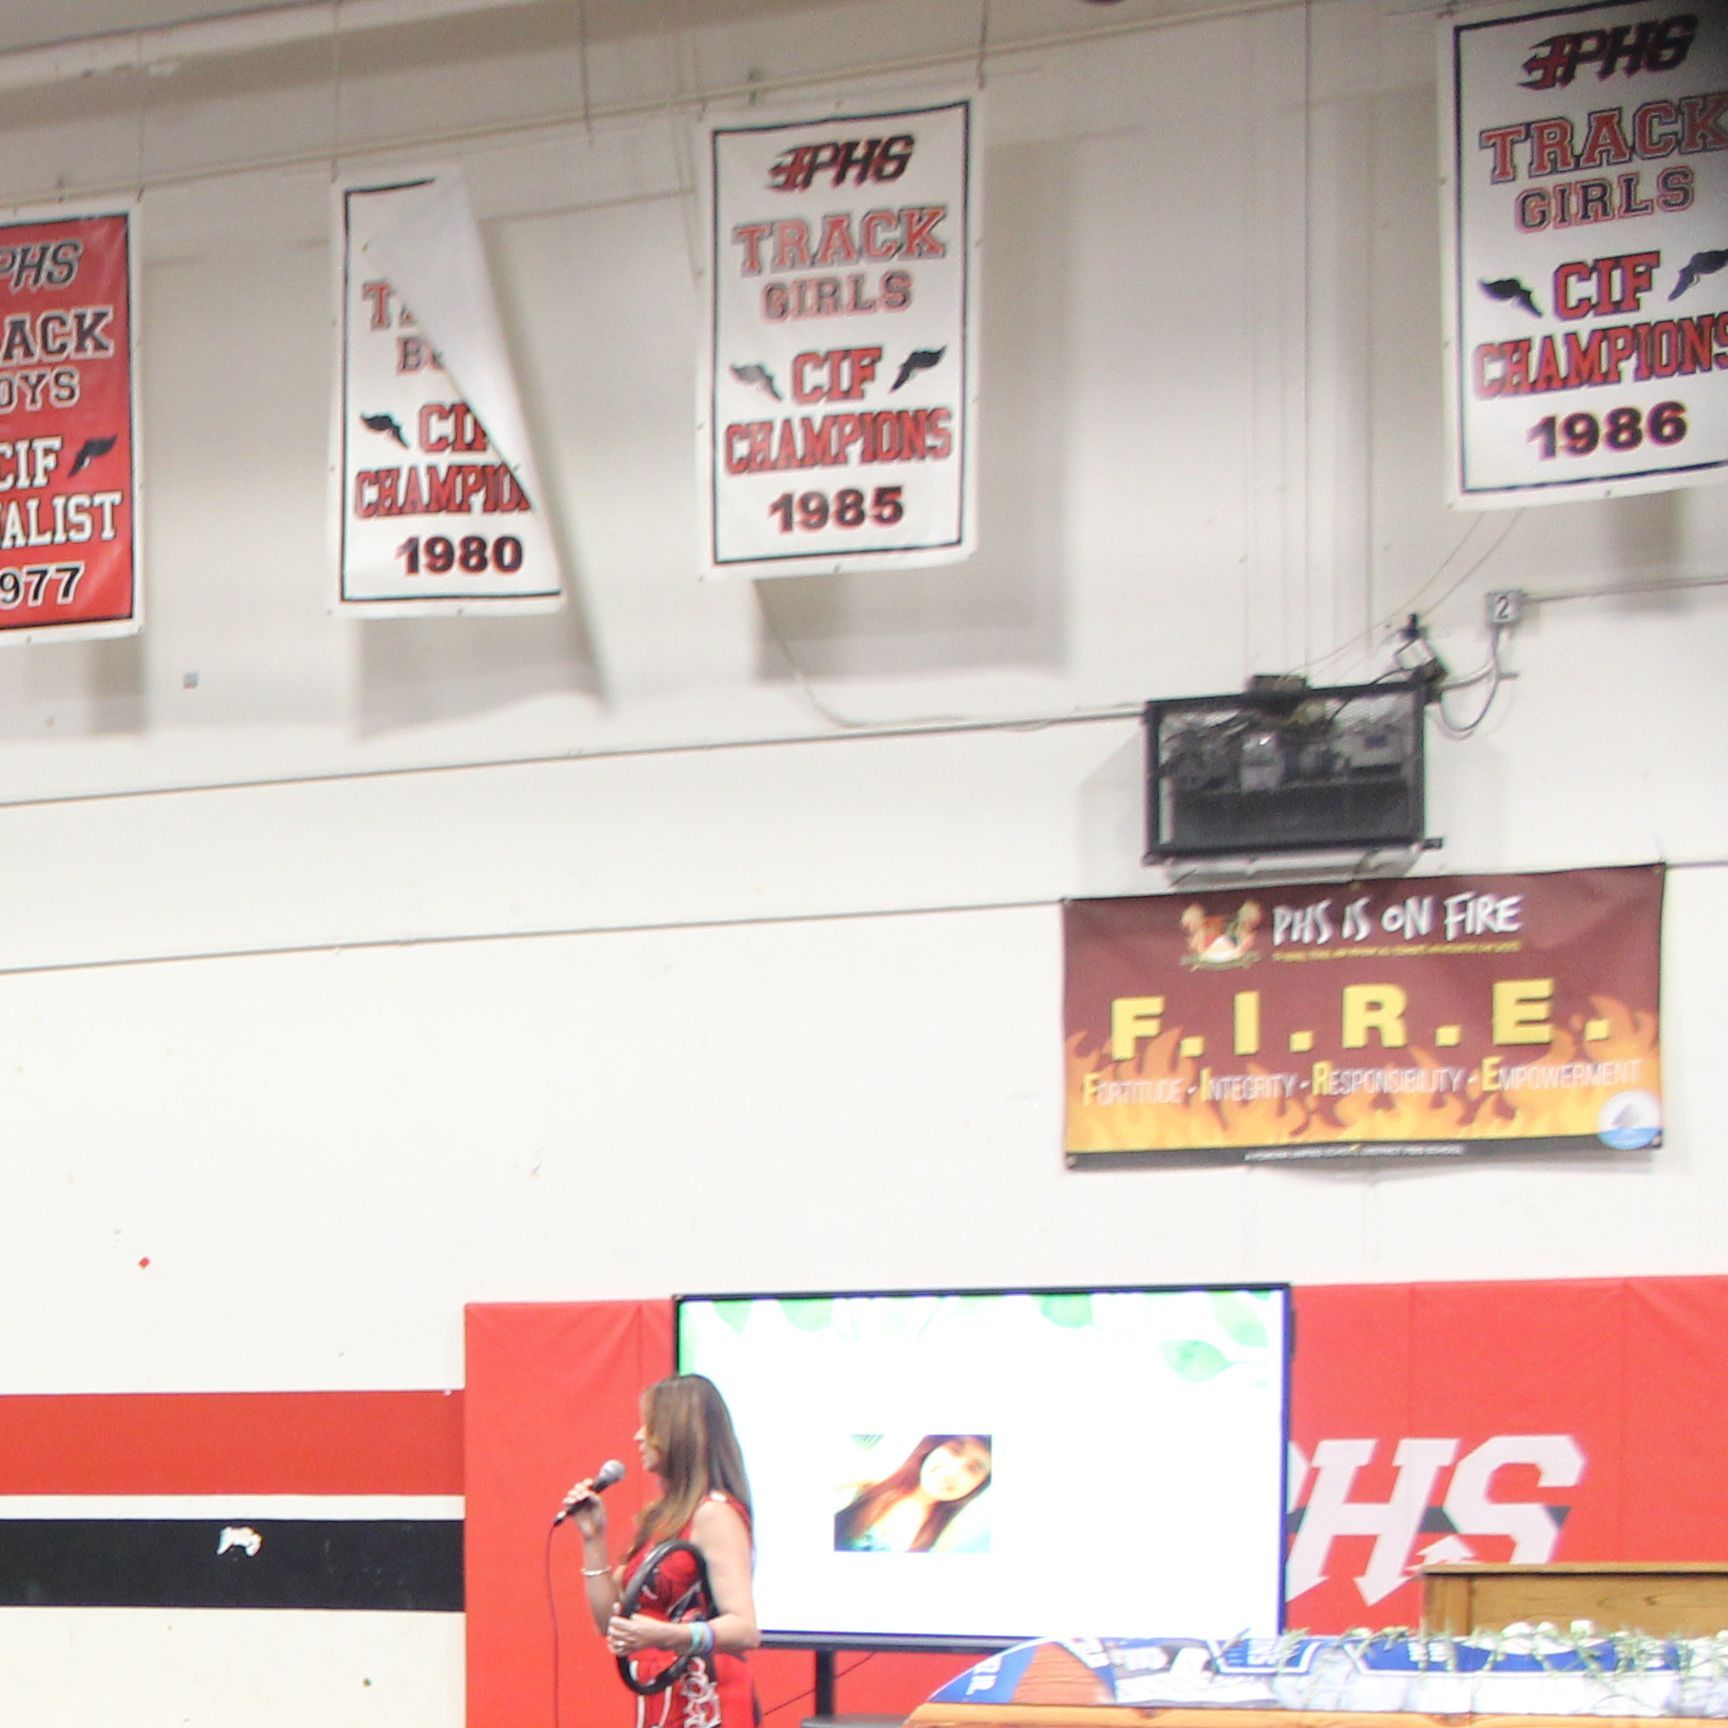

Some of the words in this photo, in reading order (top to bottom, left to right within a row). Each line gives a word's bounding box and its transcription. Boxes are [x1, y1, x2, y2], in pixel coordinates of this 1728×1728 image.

[1518, 14, 1698, 91] PHS
[767, 134, 915, 193] PHS
[1479, 89, 1728, 185] TRACK
[1514, 165, 1695, 234] GIRLS
[732, 205, 947, 277] TRACK
[762, 269, 914, 325] GIRLS
[1553, 249, 1661, 322] CIF
[789, 345, 884, 406] CIF
[724, 405, 953, 477] CHAMPIONS
[1526, 399, 1687, 460] 1986
[356, 460, 531, 520] CHAMPIO
[769, 484, 905, 535] 1985
[396, 534, 523, 576] 1980
[1495, 595, 1509, 619] 2
[1272, 899, 1332, 946] PHS
[1342, 897, 1370, 941] IS
[1381, 896, 1434, 940] ON
[1444, 890, 1524, 942] FIRE
[1082, 1072, 1184, 1106] FORTITUDE
[1199, 1067, 1295, 1102] INTEGRITY
[1312, 1060, 1464, 1096] RESPONSIBILITY
[1482, 1055, 1643, 1092] EMPOWERMENT
[1286, 1434, 1587, 1607] HS
